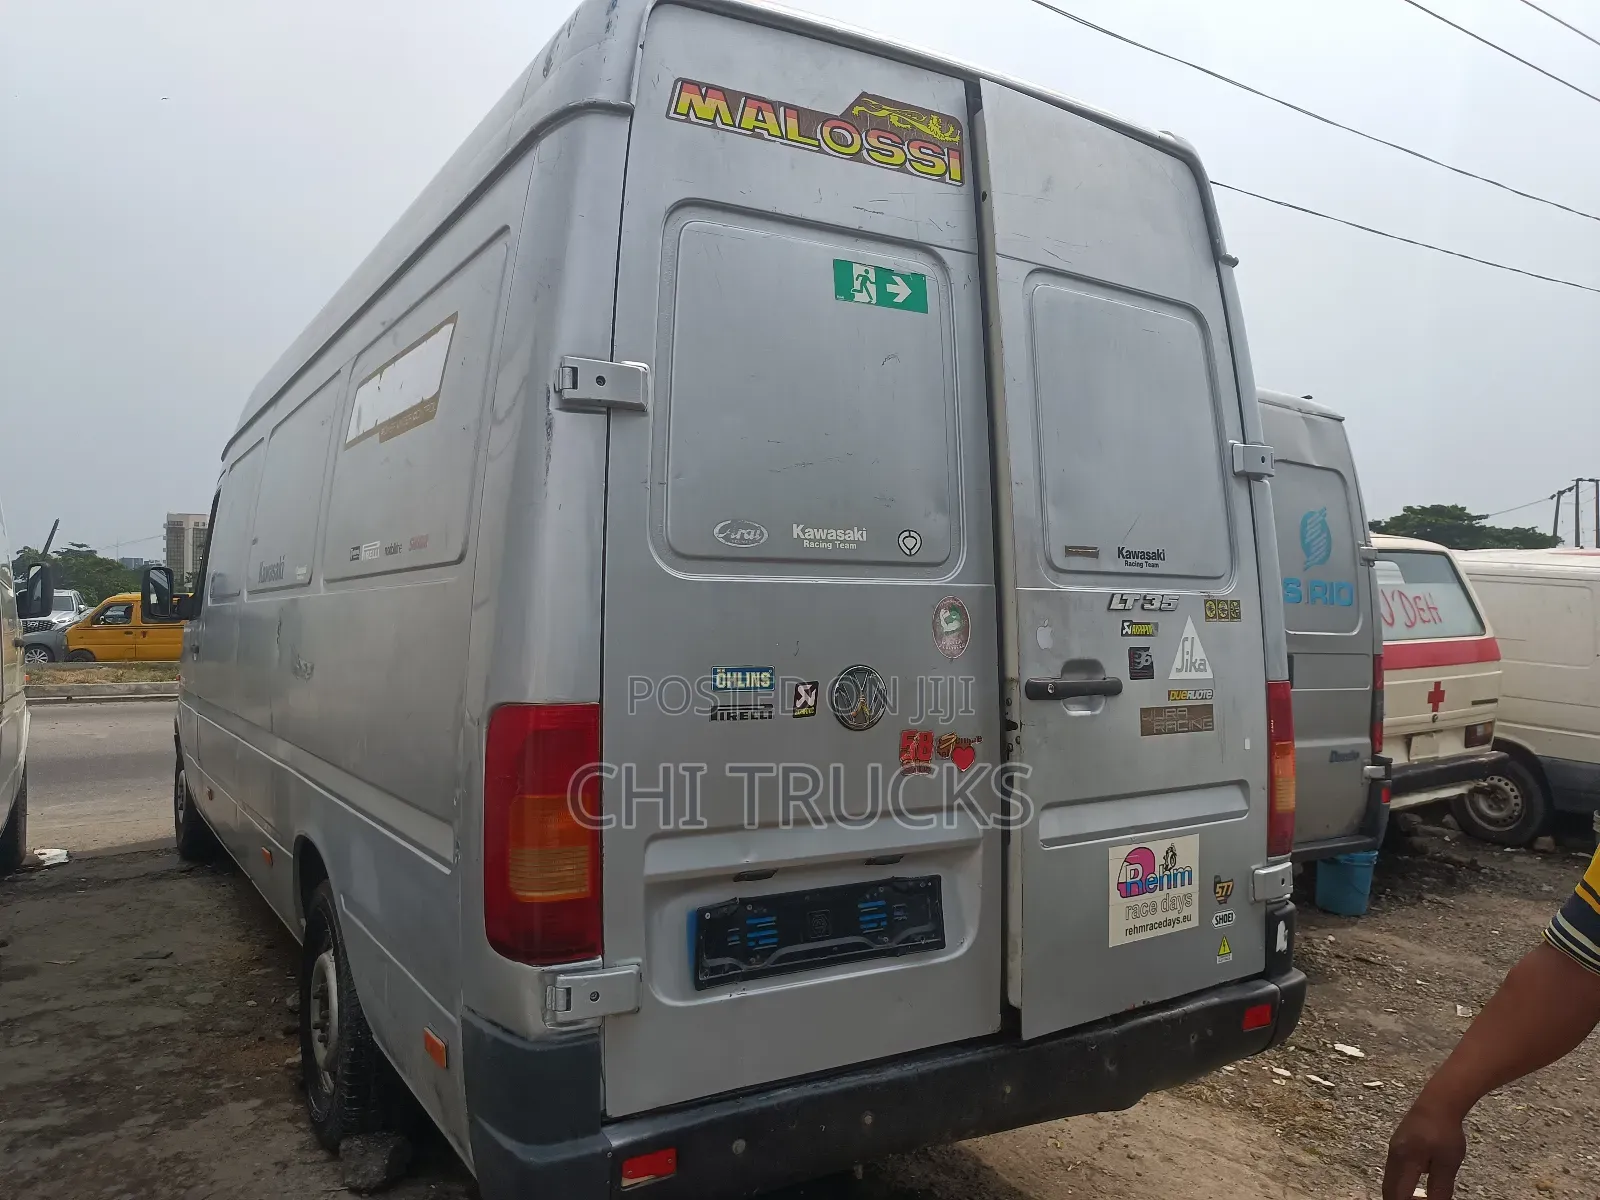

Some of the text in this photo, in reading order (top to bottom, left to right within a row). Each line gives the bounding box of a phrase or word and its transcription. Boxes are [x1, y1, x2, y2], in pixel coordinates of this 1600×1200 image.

[669, 80, 964, 186] MALOSSI
[792, 523, 868, 542] Kawasaki
[803, 540, 857, 550] Racing Team
[1117, 546, 1166, 561] Kawasaki
[1124, 560, 1144, 569] Racing
[1107, 593, 1180, 612] LT 35
[1175, 636, 1208, 673] Sika
[716, 669, 771, 689] ÖHLINS
[709, 703, 774, 721] PIRELLI
[1153, 716, 1213, 733] RACING
[1124, 863, 1193, 896] Rehm
[1125, 892, 1193, 921] race days
[1125, 913, 1192, 937] rehmracedays.eu
[1214, 912, 1234, 926] SHOEI
